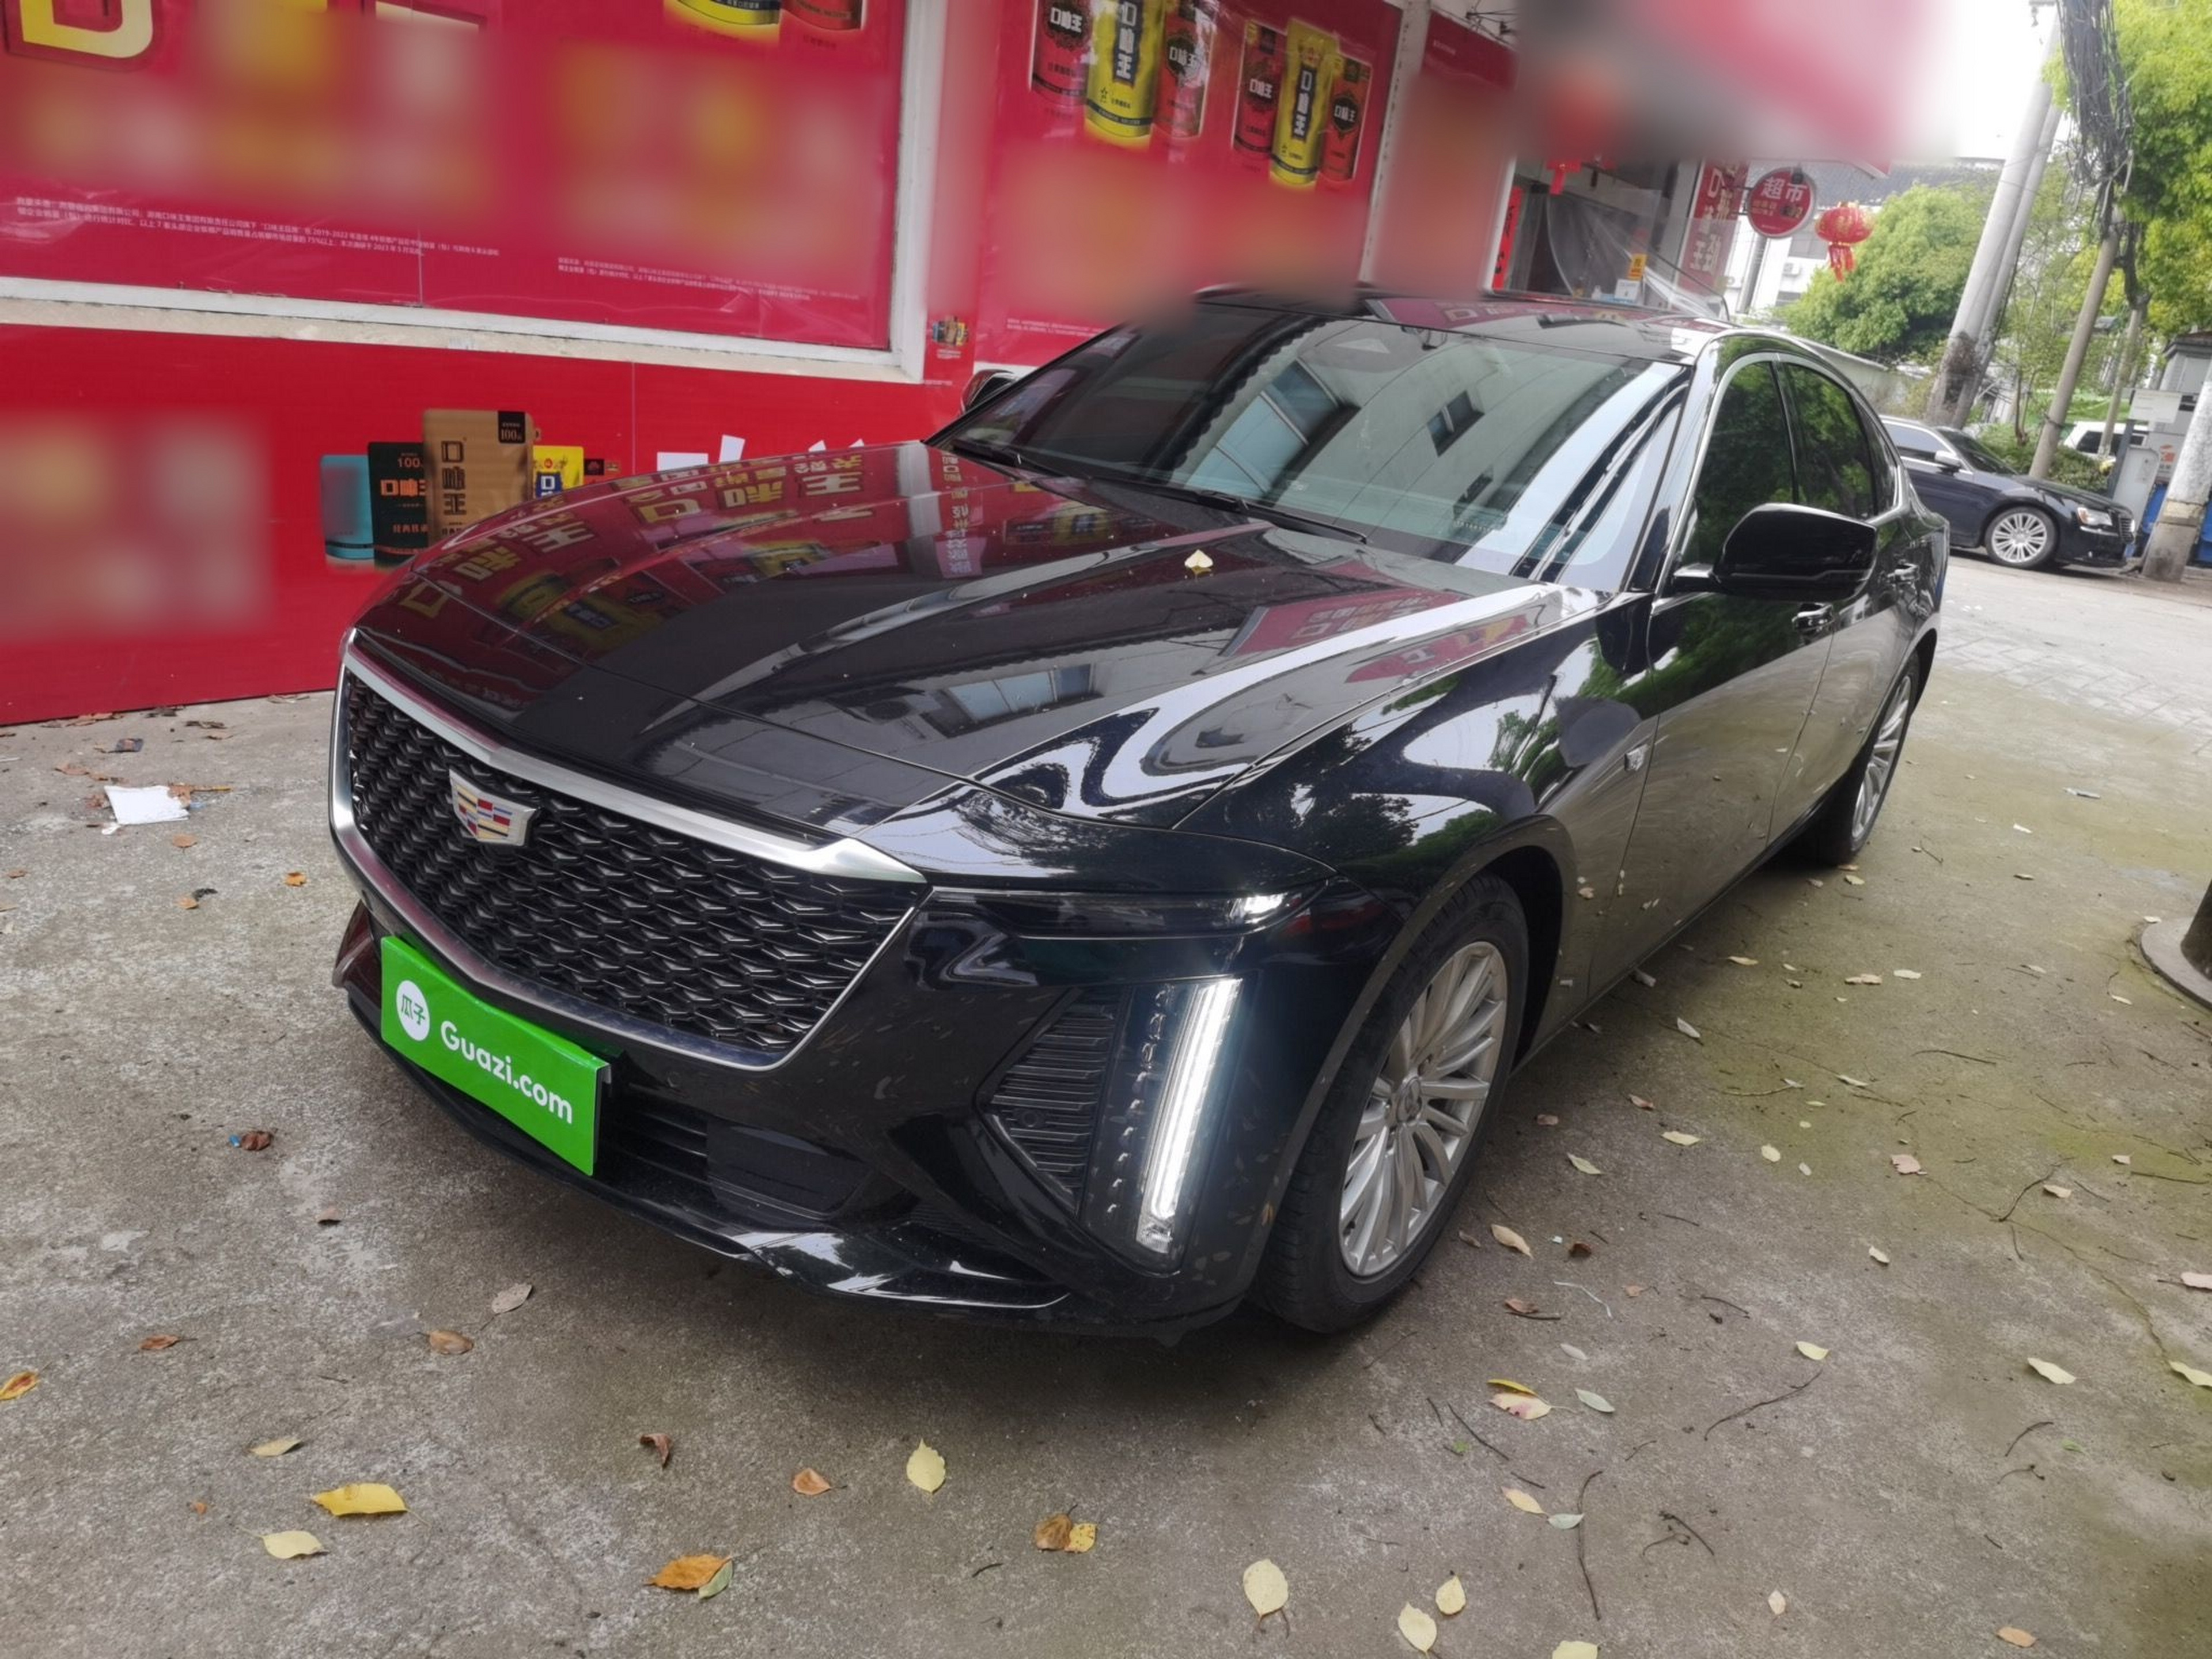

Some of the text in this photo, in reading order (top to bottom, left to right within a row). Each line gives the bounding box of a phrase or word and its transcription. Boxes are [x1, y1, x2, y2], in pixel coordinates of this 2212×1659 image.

[1761, 177, 1808, 202] 超市
[402, 995, 426, 1025] 瓜子
[441, 1020, 573, 1124] Guazi.com
